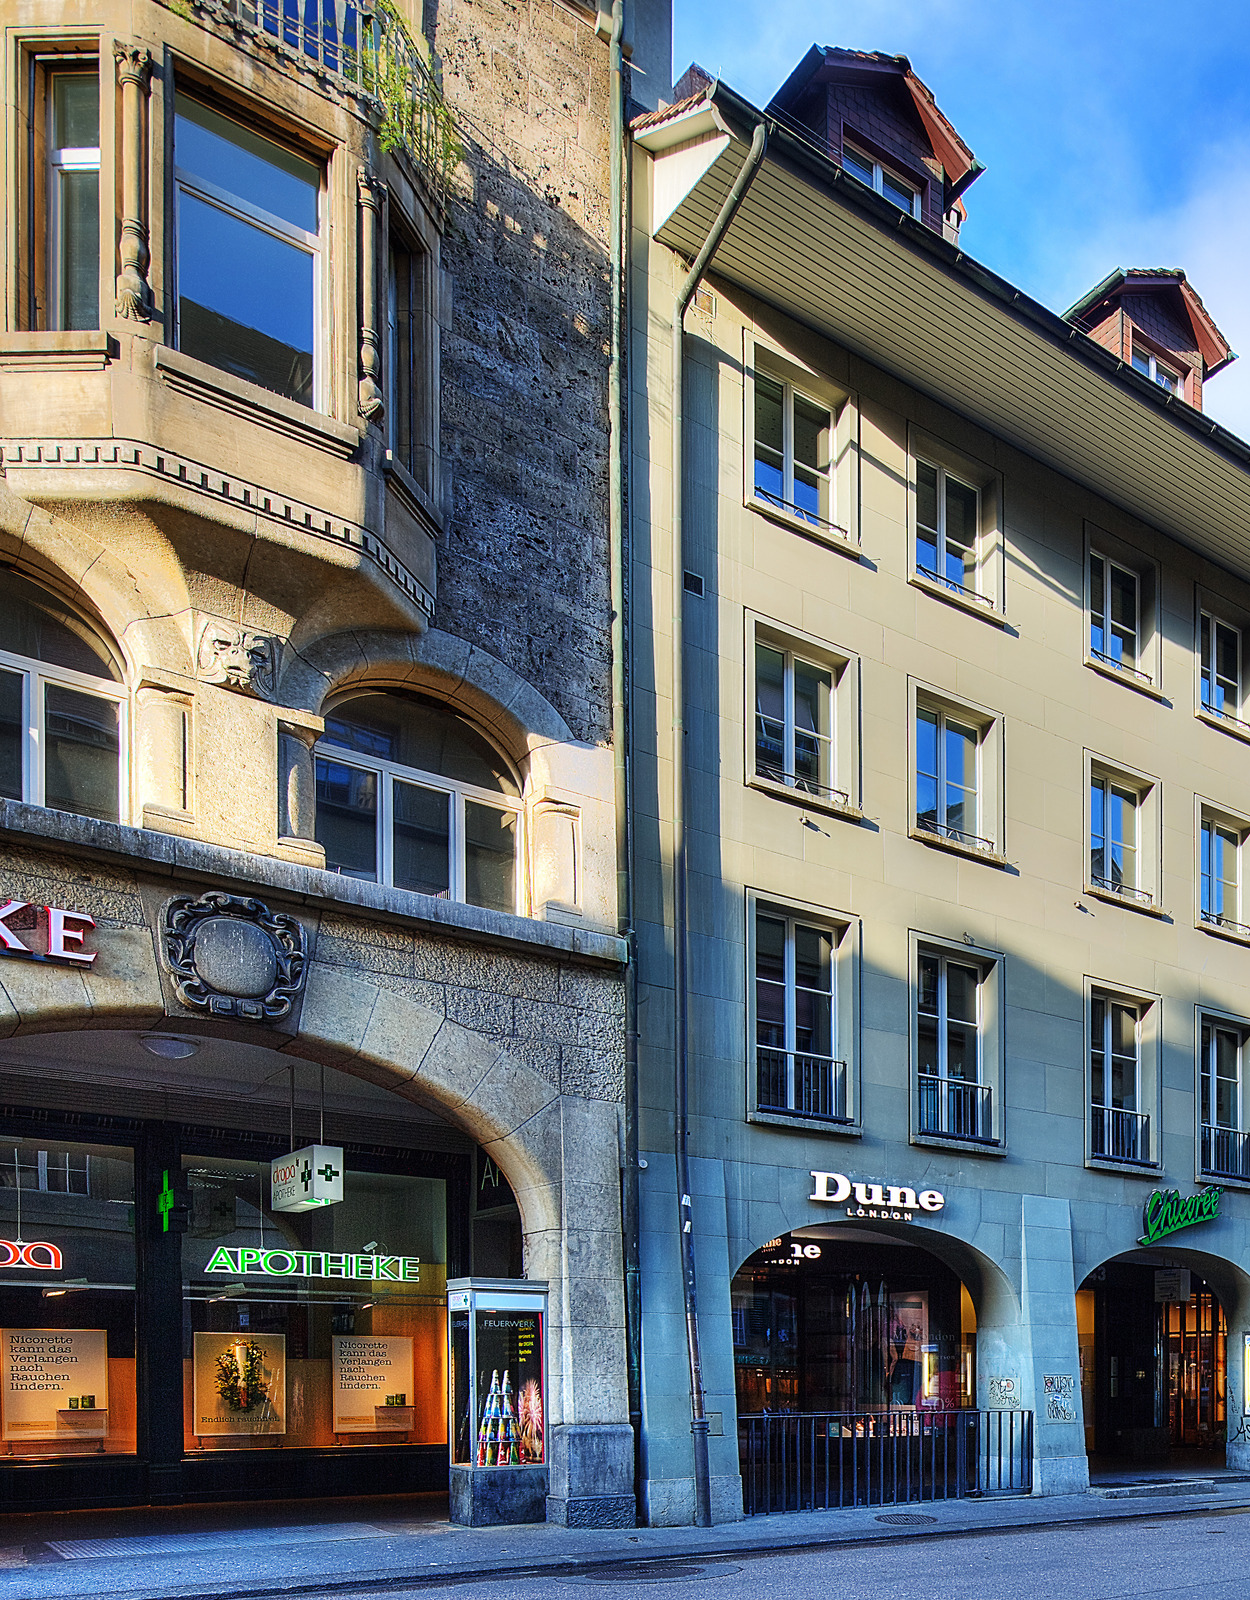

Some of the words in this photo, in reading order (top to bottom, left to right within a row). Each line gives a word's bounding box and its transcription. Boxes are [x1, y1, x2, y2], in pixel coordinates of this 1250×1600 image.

[273, 1186, 296, 1202] APOTHEKE
[808, 1170, 945, 1212] Dune
[846, 1207, 913, 1221] LONDON
[1143, 1185, 1220, 1240] Chicorée
[204, 1246, 420, 1282] APOTHEKE
[483, 1319, 535, 1328] FEUERWERK
[9, 1335, 73, 1344] Nicorette
[10, 1345, 45, 1353] kann
[48, 1345, 72, 1353] das
[339, 1341, 388, 1350] Nicorette
[339, 1349, 367, 1357] kann
[369, 1349, 387, 1357] das
[10, 1354, 79, 1365] Verlangen
[339, 1357, 392, 1367] Verlangen
[10, 1364, 44, 1372] nach
[339, 1365, 366, 1373] nach
[10, 1373, 71, 1381] Rauchen
[339, 1373, 386, 1381] Rauchen
[10, 1382, 64, 1391] lindern.
[339, 1381, 382, 1390] lindern.
